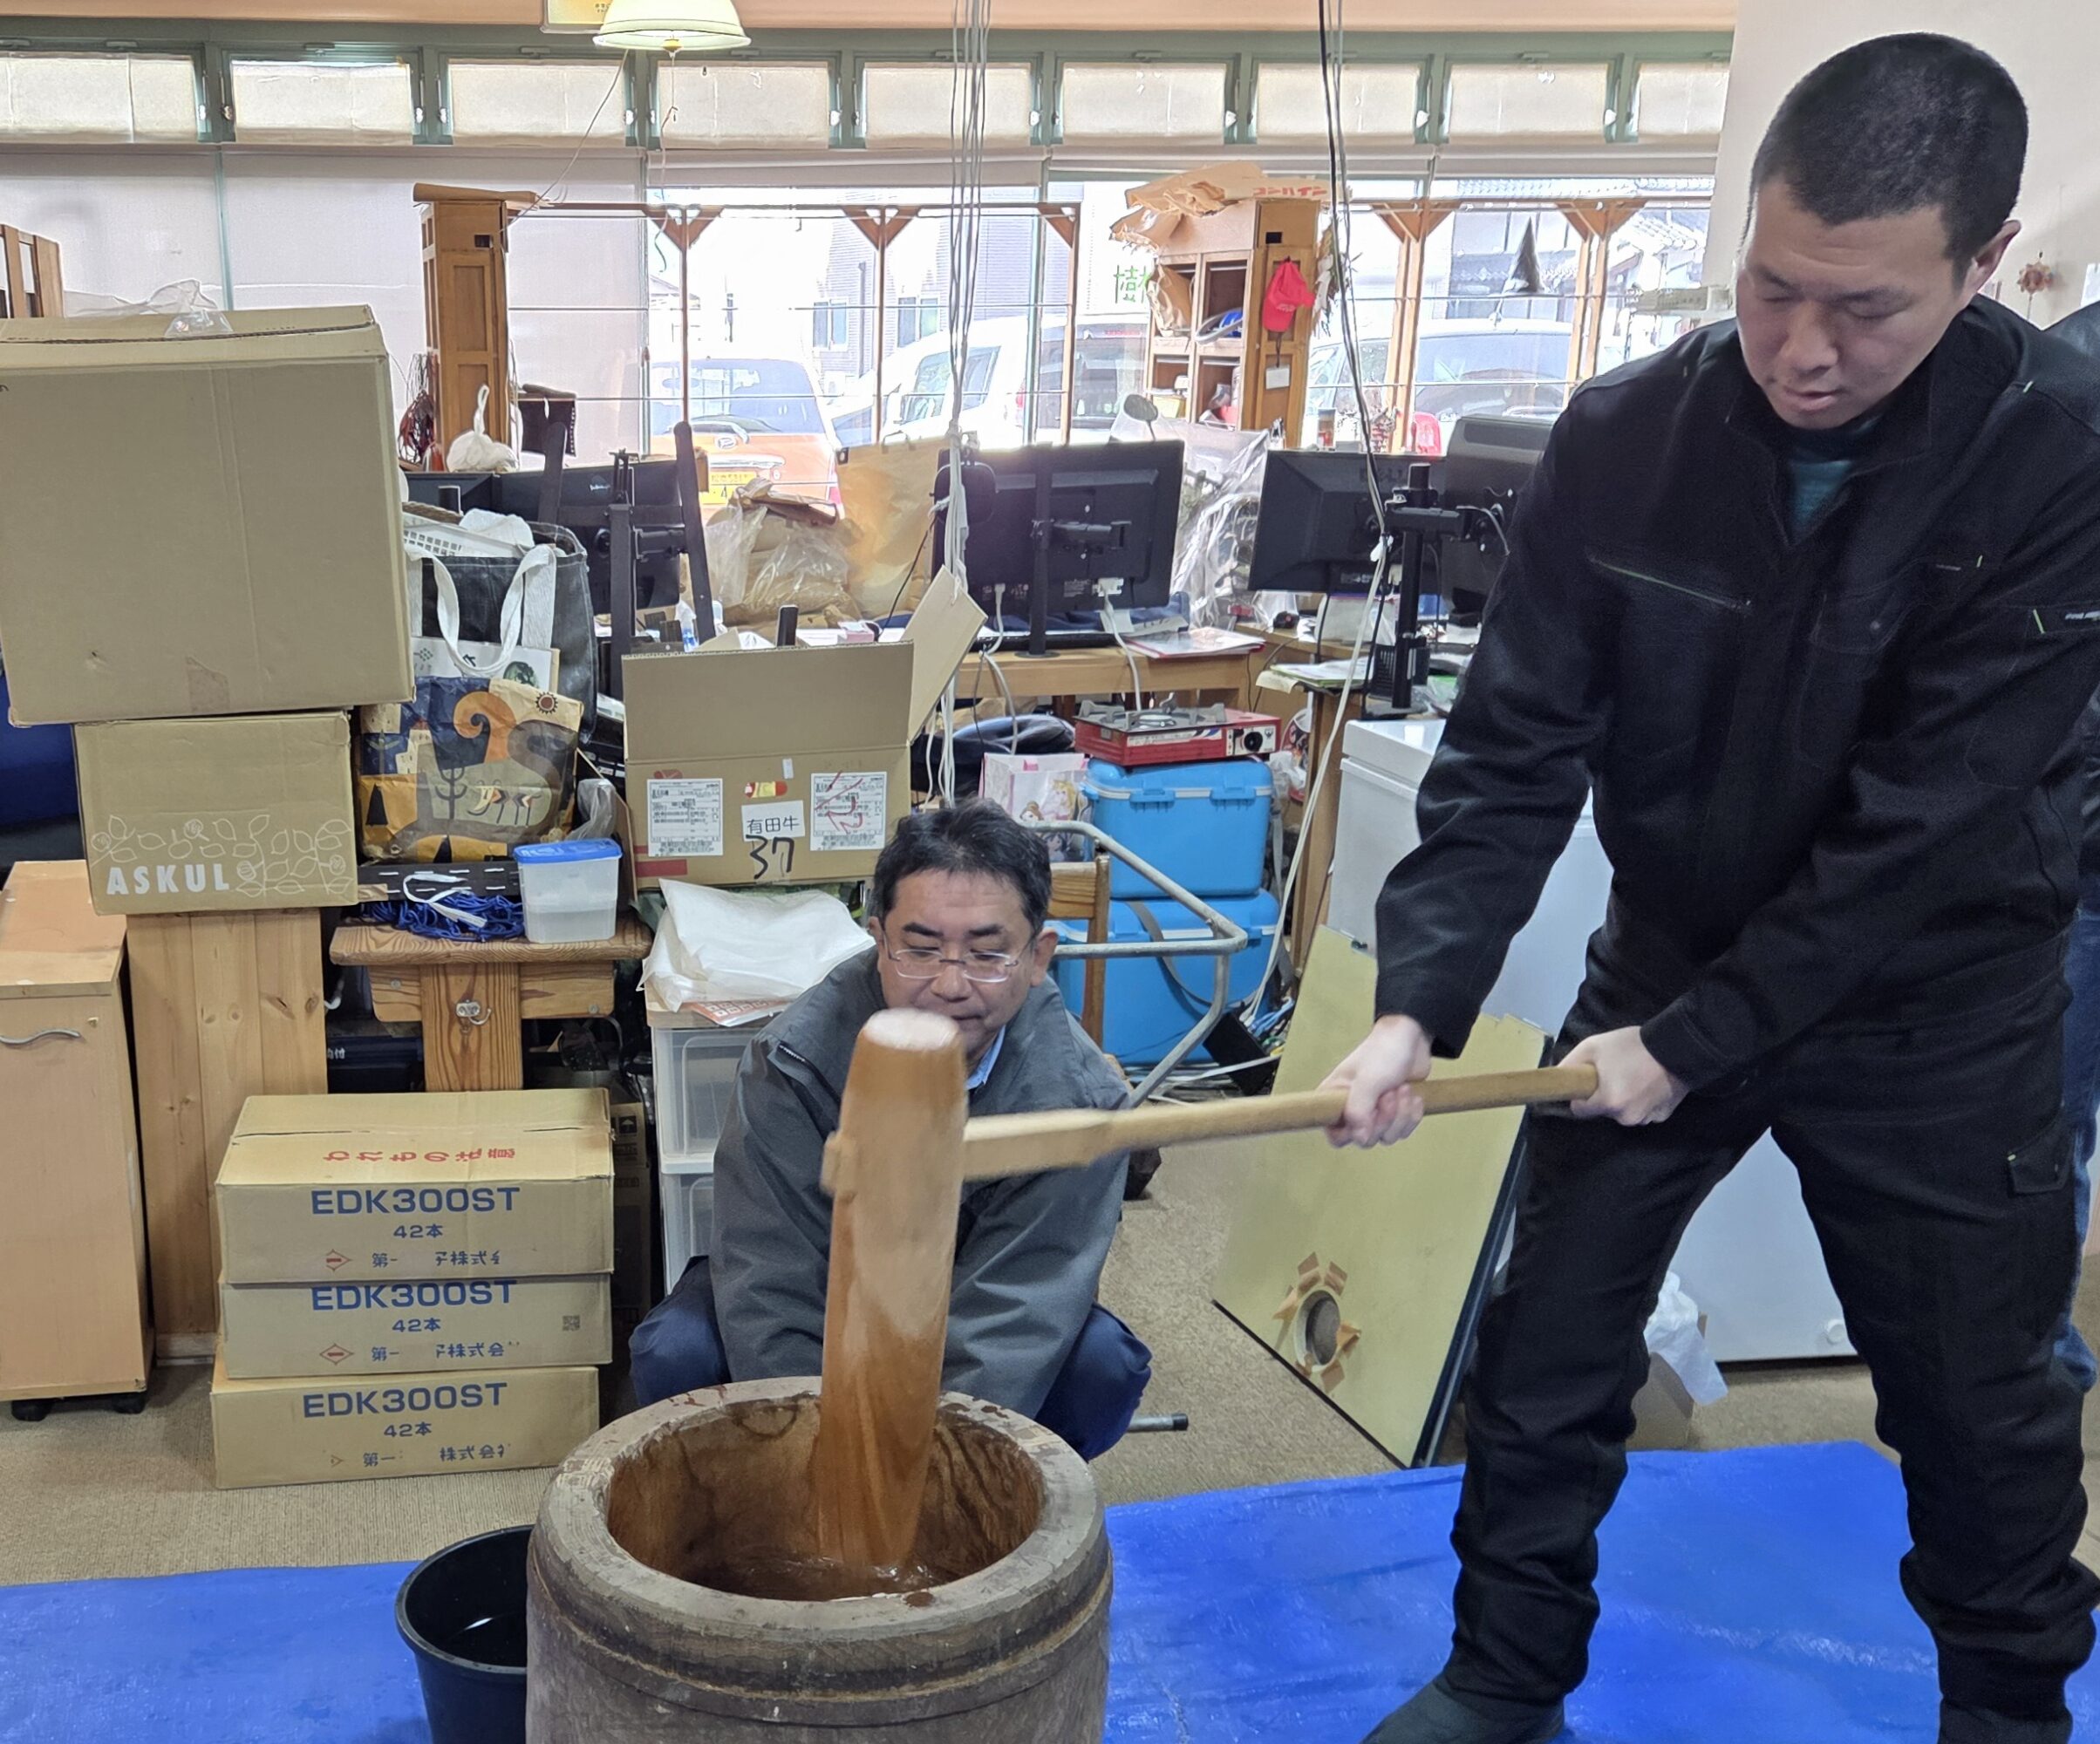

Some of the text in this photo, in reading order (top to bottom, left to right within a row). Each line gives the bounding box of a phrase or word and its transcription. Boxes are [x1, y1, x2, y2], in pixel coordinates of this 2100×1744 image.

[747, 815, 800, 834] 有田牛
[746, 835, 794, 879] 37
[106, 863, 229, 895] ASKUL
[323, 1148, 515, 1162] われもの注意
[311, 1187, 521, 1215] EDK300ST
[393, 1223, 443, 1238] 42本
[311, 1279, 517, 1311] EDK300ST
[392, 1318, 441, 1332] 42本
[303, 1382, 508, 1419] EDK300ST
[384, 1421, 432, 1437] 42本
